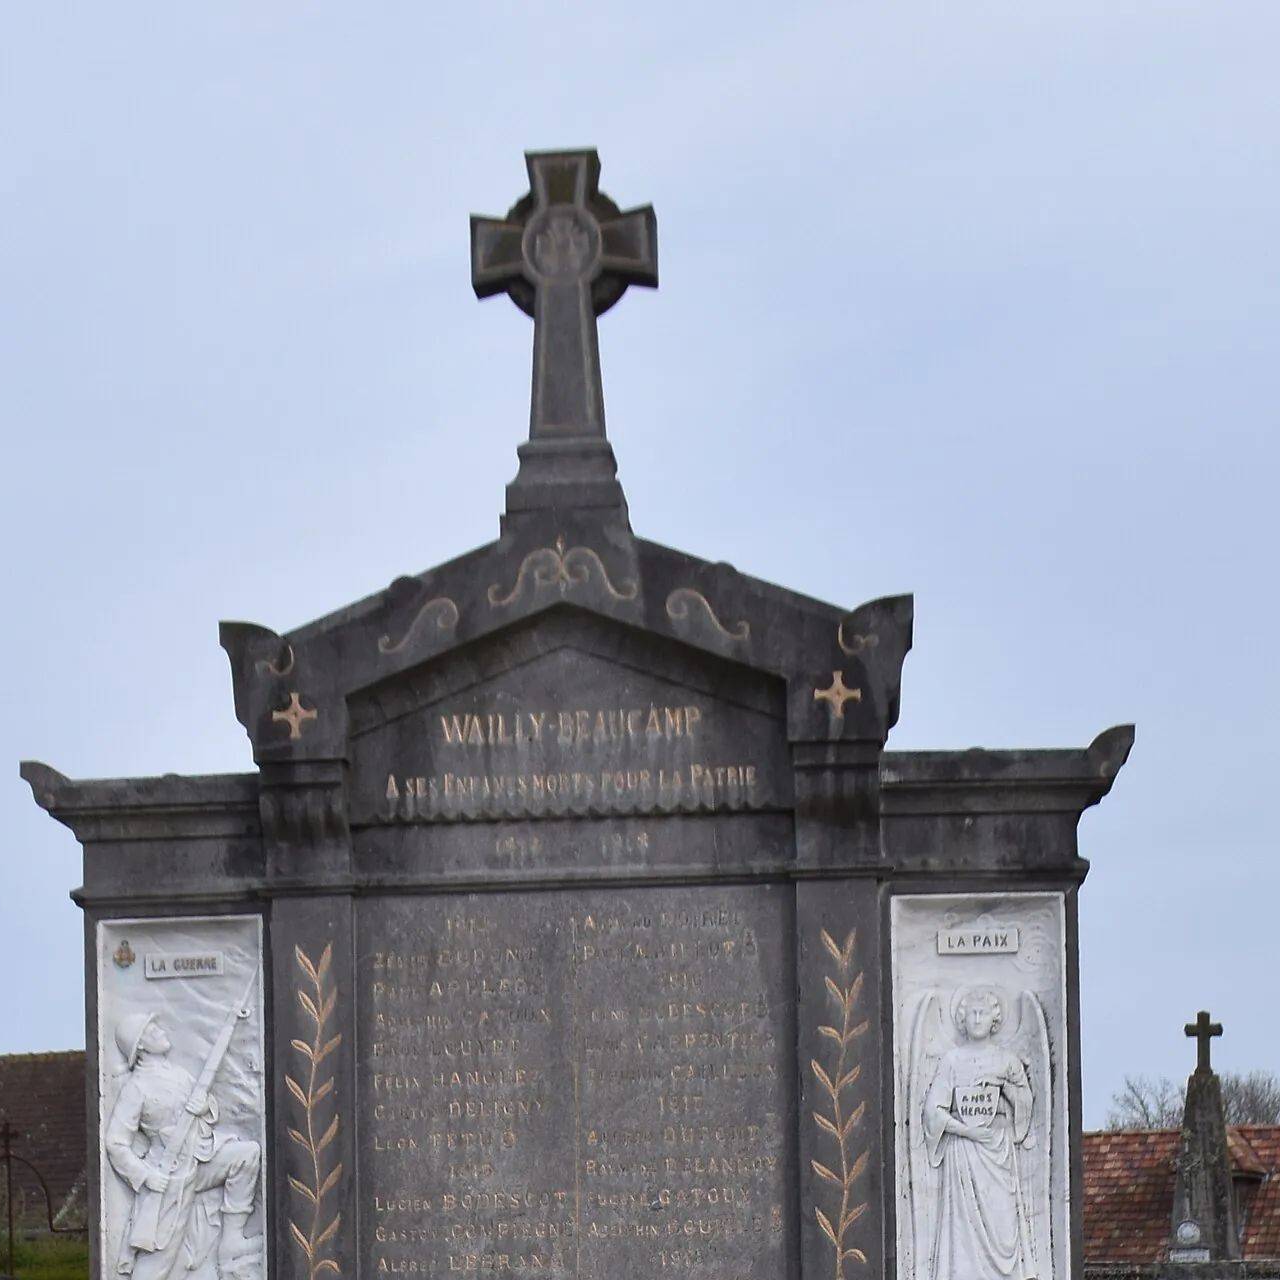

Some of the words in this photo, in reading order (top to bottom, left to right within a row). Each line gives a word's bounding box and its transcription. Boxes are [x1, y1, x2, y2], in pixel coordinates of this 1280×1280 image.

[440, 705, 702, 744] WAILLY-BEAUCAMP
[386, 773, 400, 799] A
[406, 776, 440, 798] SES
[443, 772, 527, 797] ENFANTS
[532, 772, 595, 796] MORTS
[600, 768, 651, 793] POUR
[658, 768, 684, 791] LA
[690, 764, 756, 788] PATRIE
[947, 935, 966, 948] LA
[972, 933, 1008, 948] PAIX
[151, 960, 167, 972] LA
[172, 957, 218, 972] GUERRE
[971, 1093, 993, 1103] NOS
[375, 1196, 432, 1212] LUCIEN
[375, 1224, 440, 1243] GASTON
[378, 1256, 439, 1273] ALFRED
